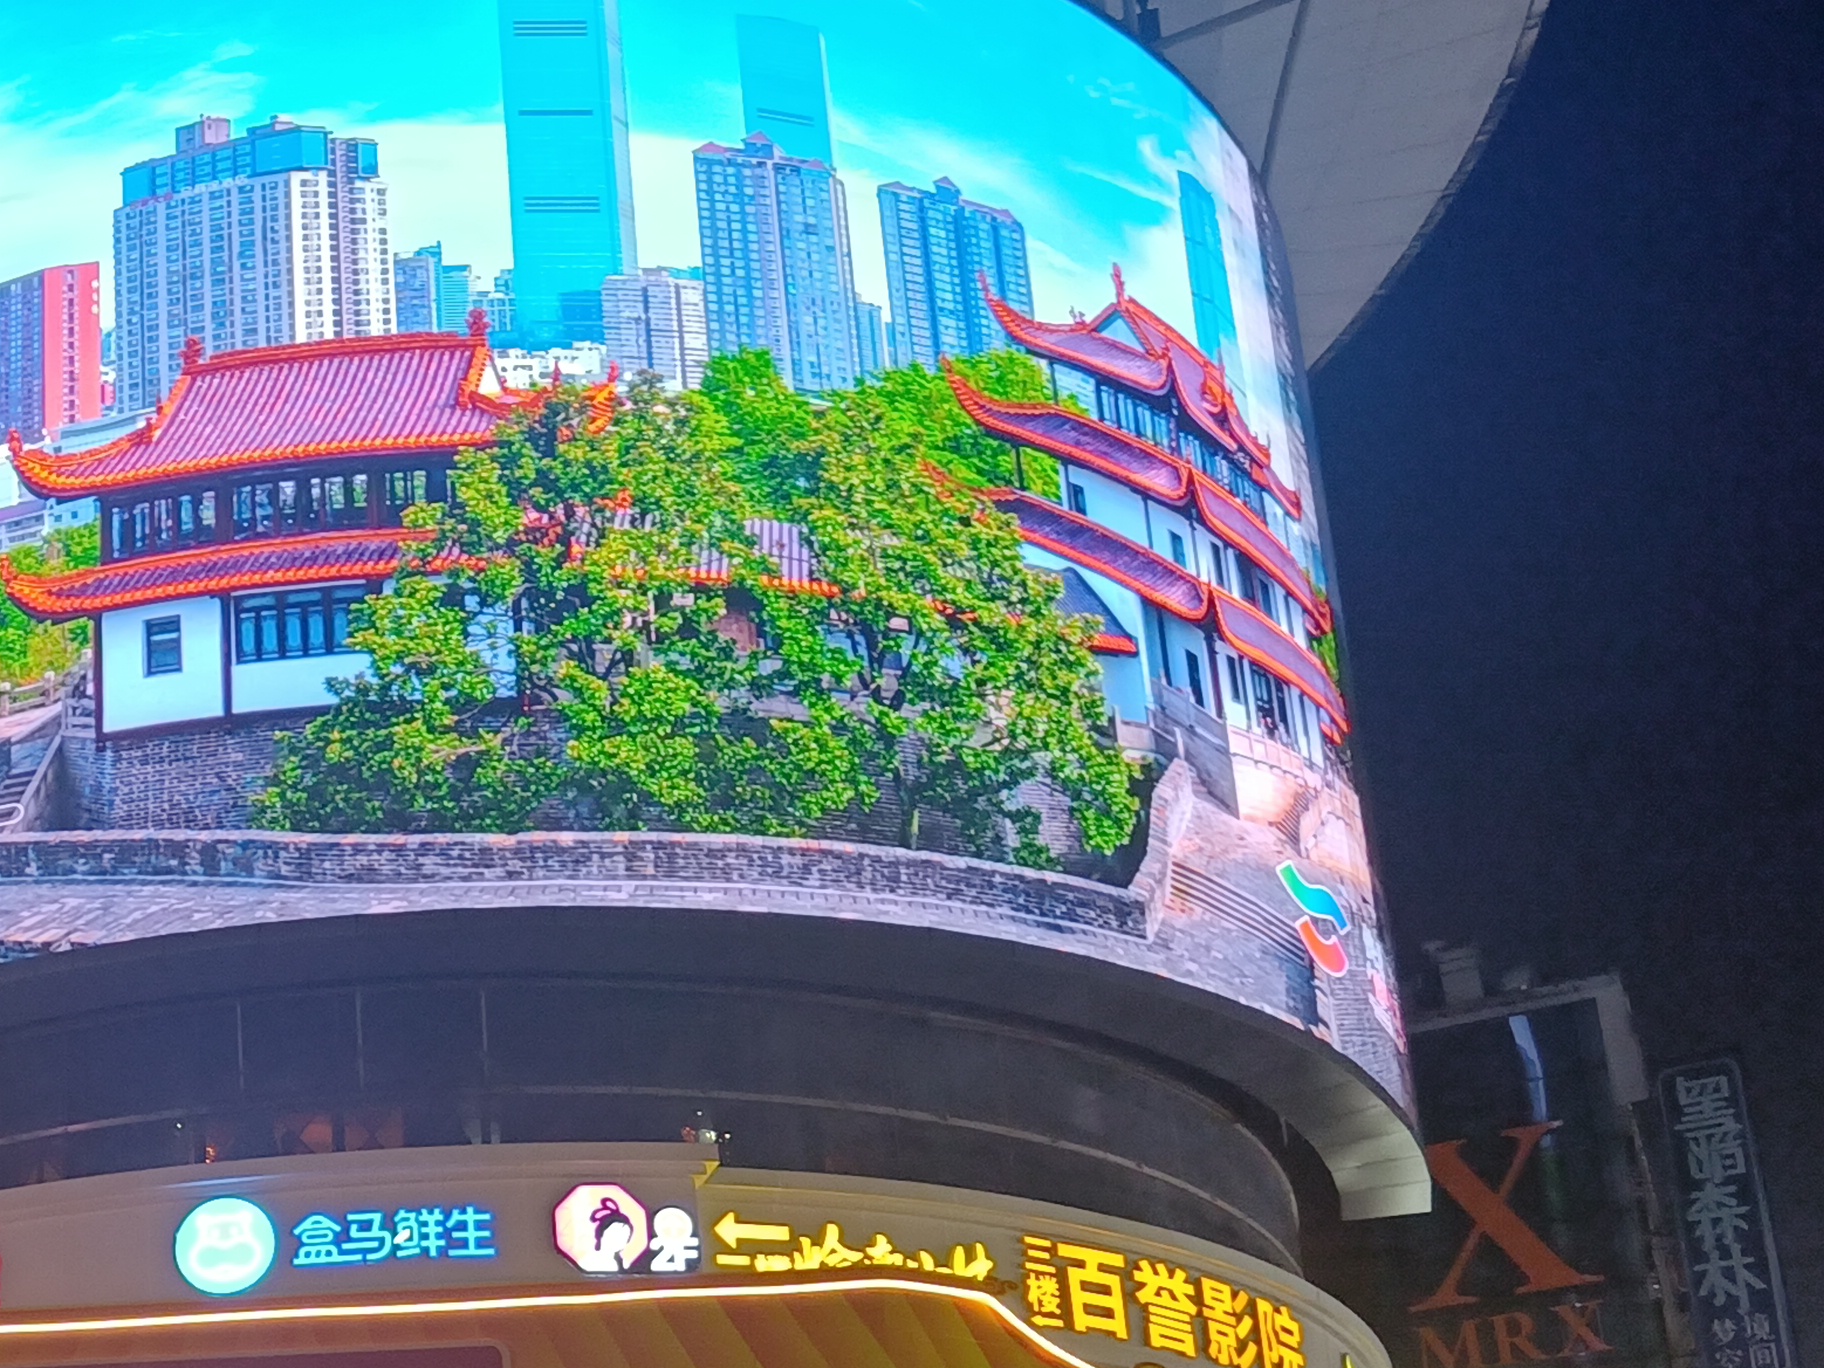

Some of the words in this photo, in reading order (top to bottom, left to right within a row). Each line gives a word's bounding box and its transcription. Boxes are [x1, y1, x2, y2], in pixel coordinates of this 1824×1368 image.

[291, 1205, 497, 1268] 盒马鲜生
[1024, 1237, 1062, 1314] 三楼
